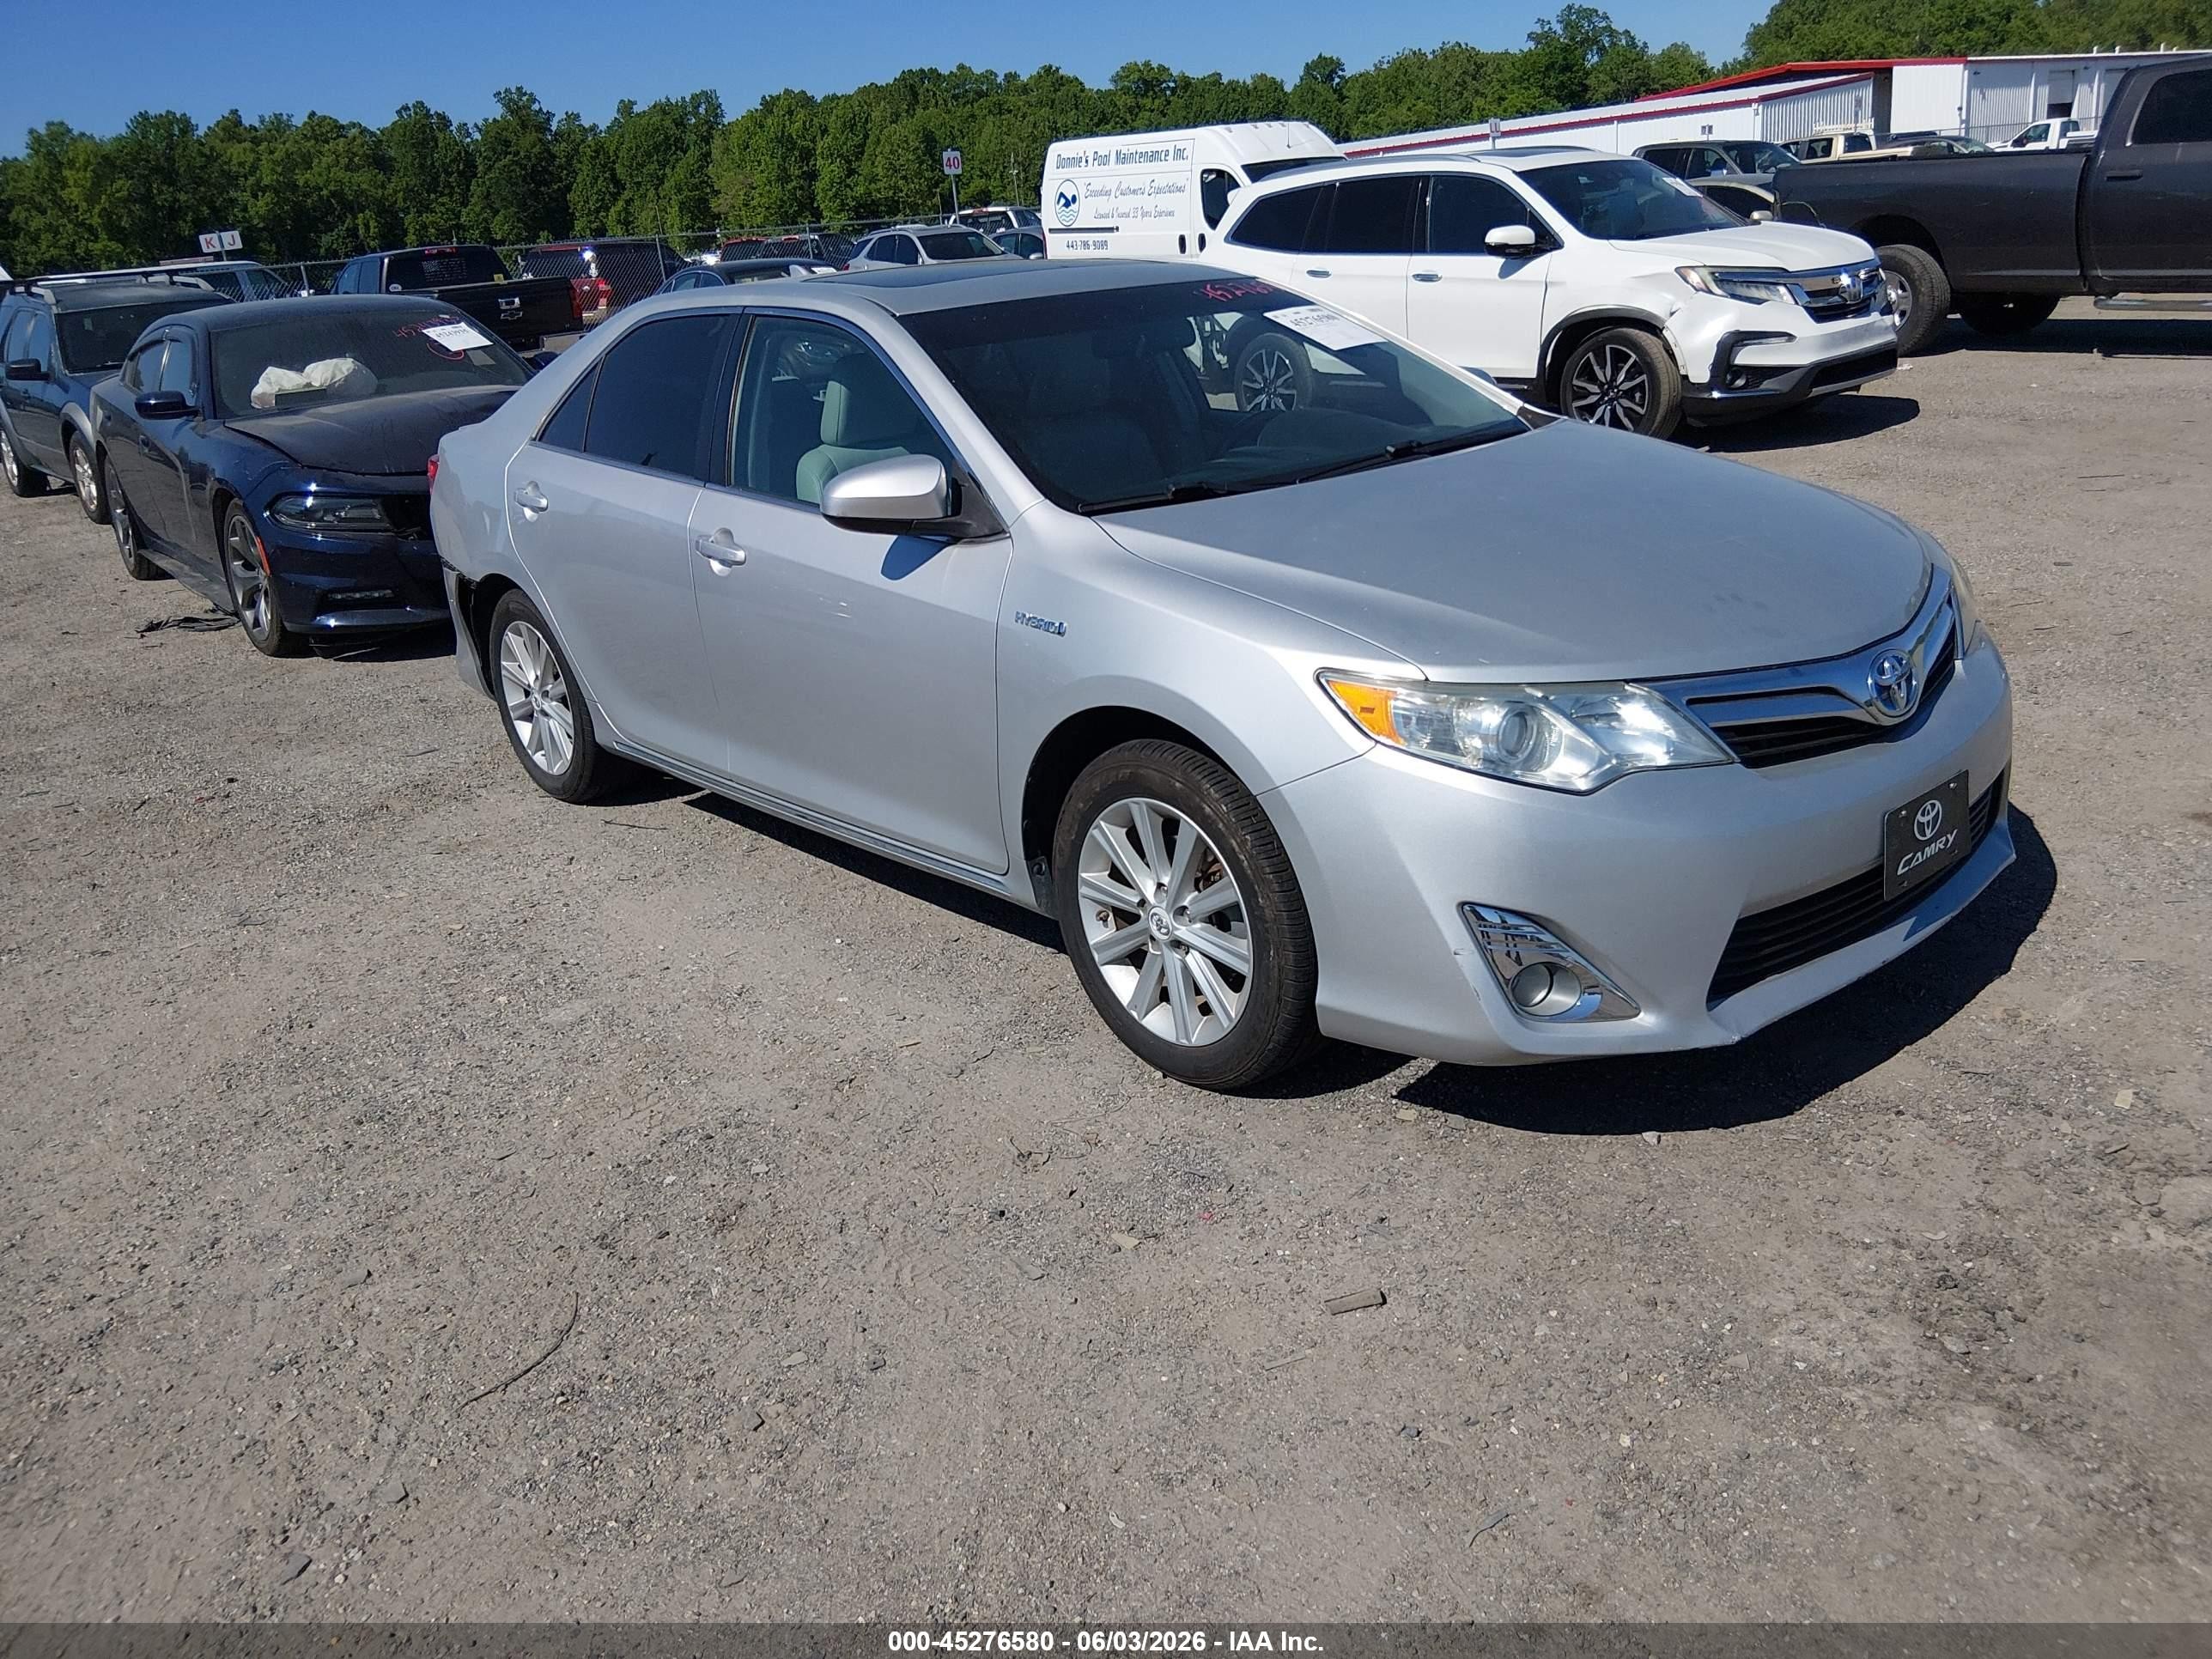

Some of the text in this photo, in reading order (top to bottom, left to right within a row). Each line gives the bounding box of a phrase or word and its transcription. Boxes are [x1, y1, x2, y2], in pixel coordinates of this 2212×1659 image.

[945, 156, 960, 170] 40
[1056, 144, 1188, 169] Donnie's Pool Maintenance Inc.
[204, 237, 216, 249] K
[228, 234, 236, 246] J
[1014, 611, 1057, 635] HYBRID
[1897, 829, 1959, 876] CAMRY
